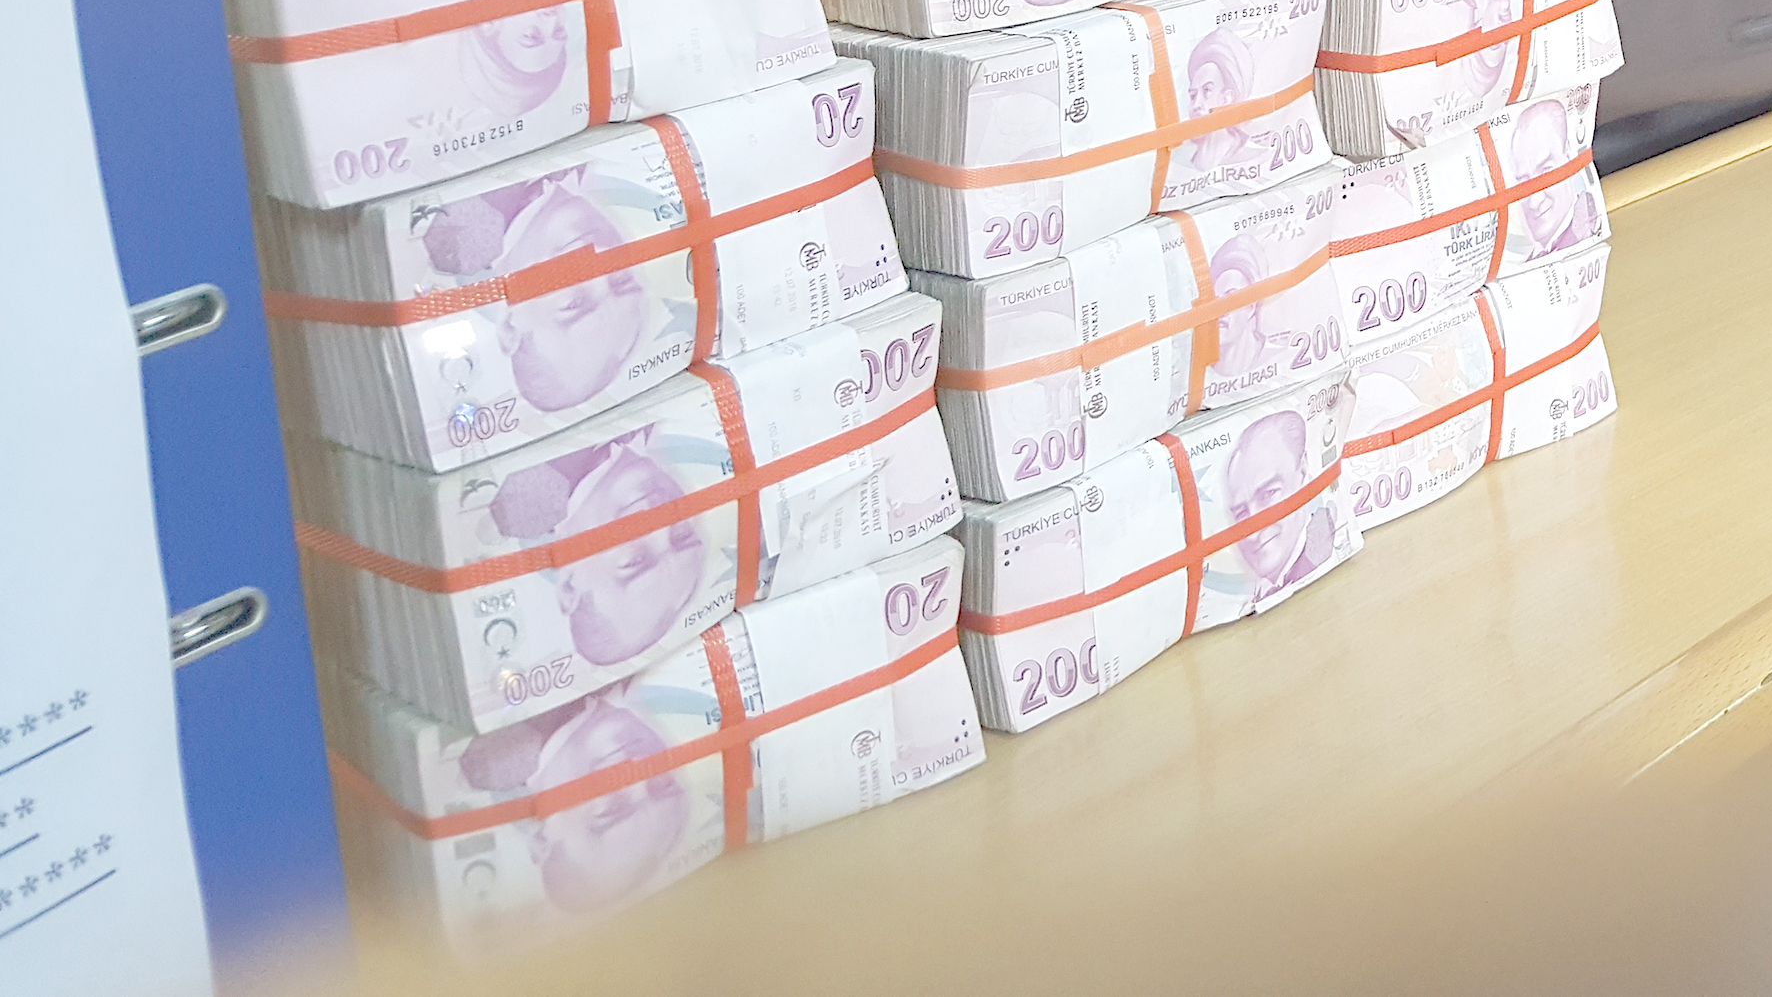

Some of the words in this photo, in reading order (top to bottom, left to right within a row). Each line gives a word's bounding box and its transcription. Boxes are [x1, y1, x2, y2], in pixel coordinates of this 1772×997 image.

[984, 64, 1034, 85] TÜRKİYE
[334, 137, 412, 186] 200
[1269, 117, 1314, 171] 200
[1305, 185, 1333, 221] 200
[983, 205, 1064, 260] 200
[1000, 285, 1052, 307] TÜRKİYE
[1579, 258, 1600, 289] 200
[1352, 271, 1427, 332] 200
[1290, 315, 1341, 370] 200
[1572, 370, 1609, 419] 200
[447, 397, 520, 448] 200
[1012, 420, 1086, 482] 200
[1350, 466, 1412, 517] 200
[1003, 512, 1060, 543] TÜRKİYE
[504, 655, 574, 706] 200
